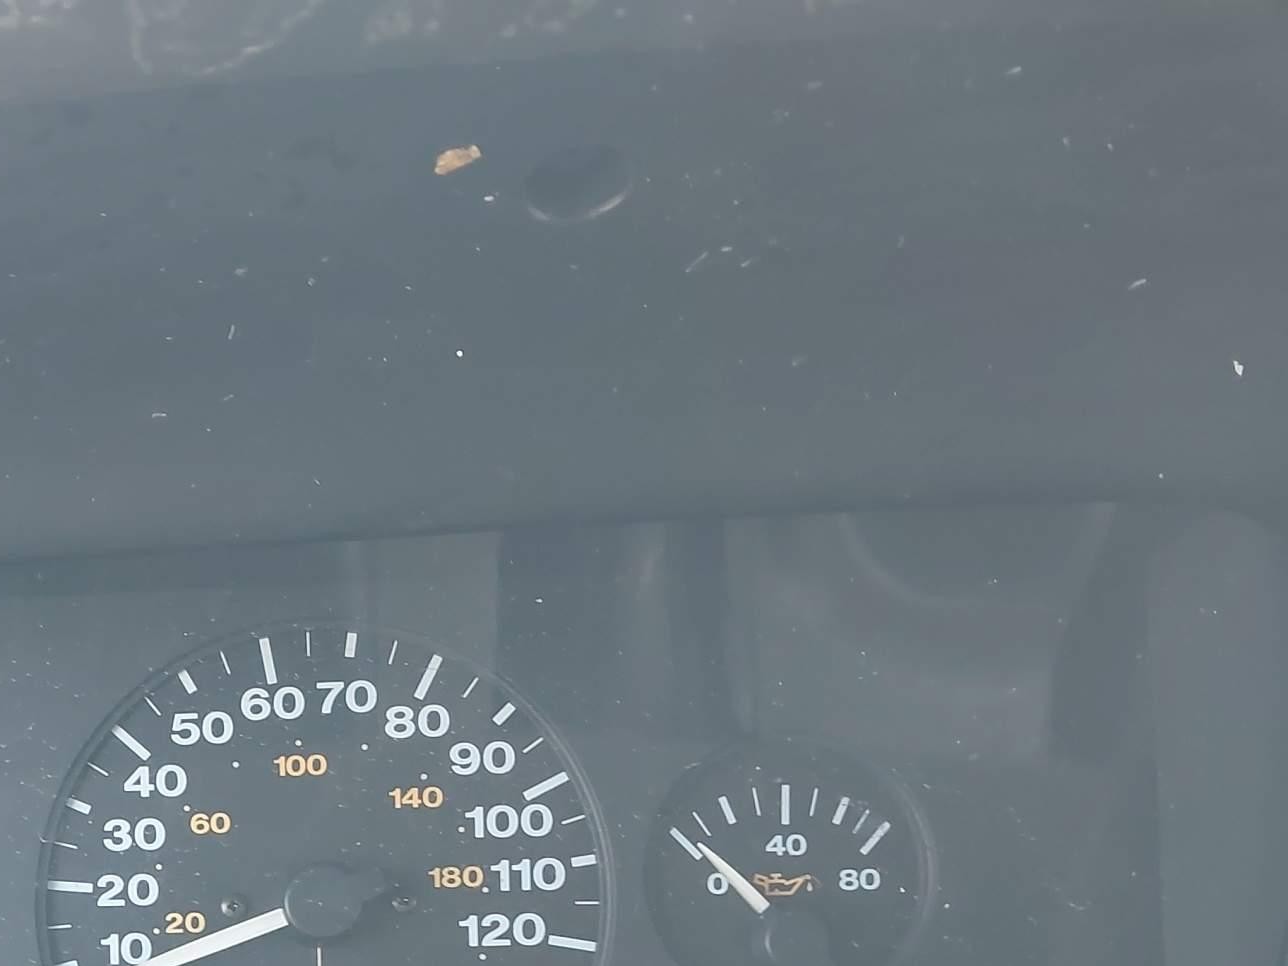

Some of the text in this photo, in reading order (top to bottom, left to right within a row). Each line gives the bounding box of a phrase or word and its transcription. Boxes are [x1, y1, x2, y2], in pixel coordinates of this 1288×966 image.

[239, 686, 306, 722] 60
[315, 679, 378, 715] 70
[170, 711, 235, 746] 50
[384, 704, 451, 739] 80
[273, 754, 329, 777] 100
[449, 741, 516, 776] 90
[123, 764, 188, 798] 40
[388, 785, 445, 809] 140
[102, 817, 167, 852] 30
[189, 812, 232, 835] 60
[464, 803, 554, 839] 100
[764, 833, 808, 857] 40
[96, 873, 160, 908] 20
[428, 865, 485, 889] 180
[490, 857, 566, 892] 110
[706, 872, 730, 895] 0
[838, 868, 881, 891] 80
[164, 912, 206, 935] 20
[458, 912, 547, 948] 120
[100, 932, 153, 966] 10
